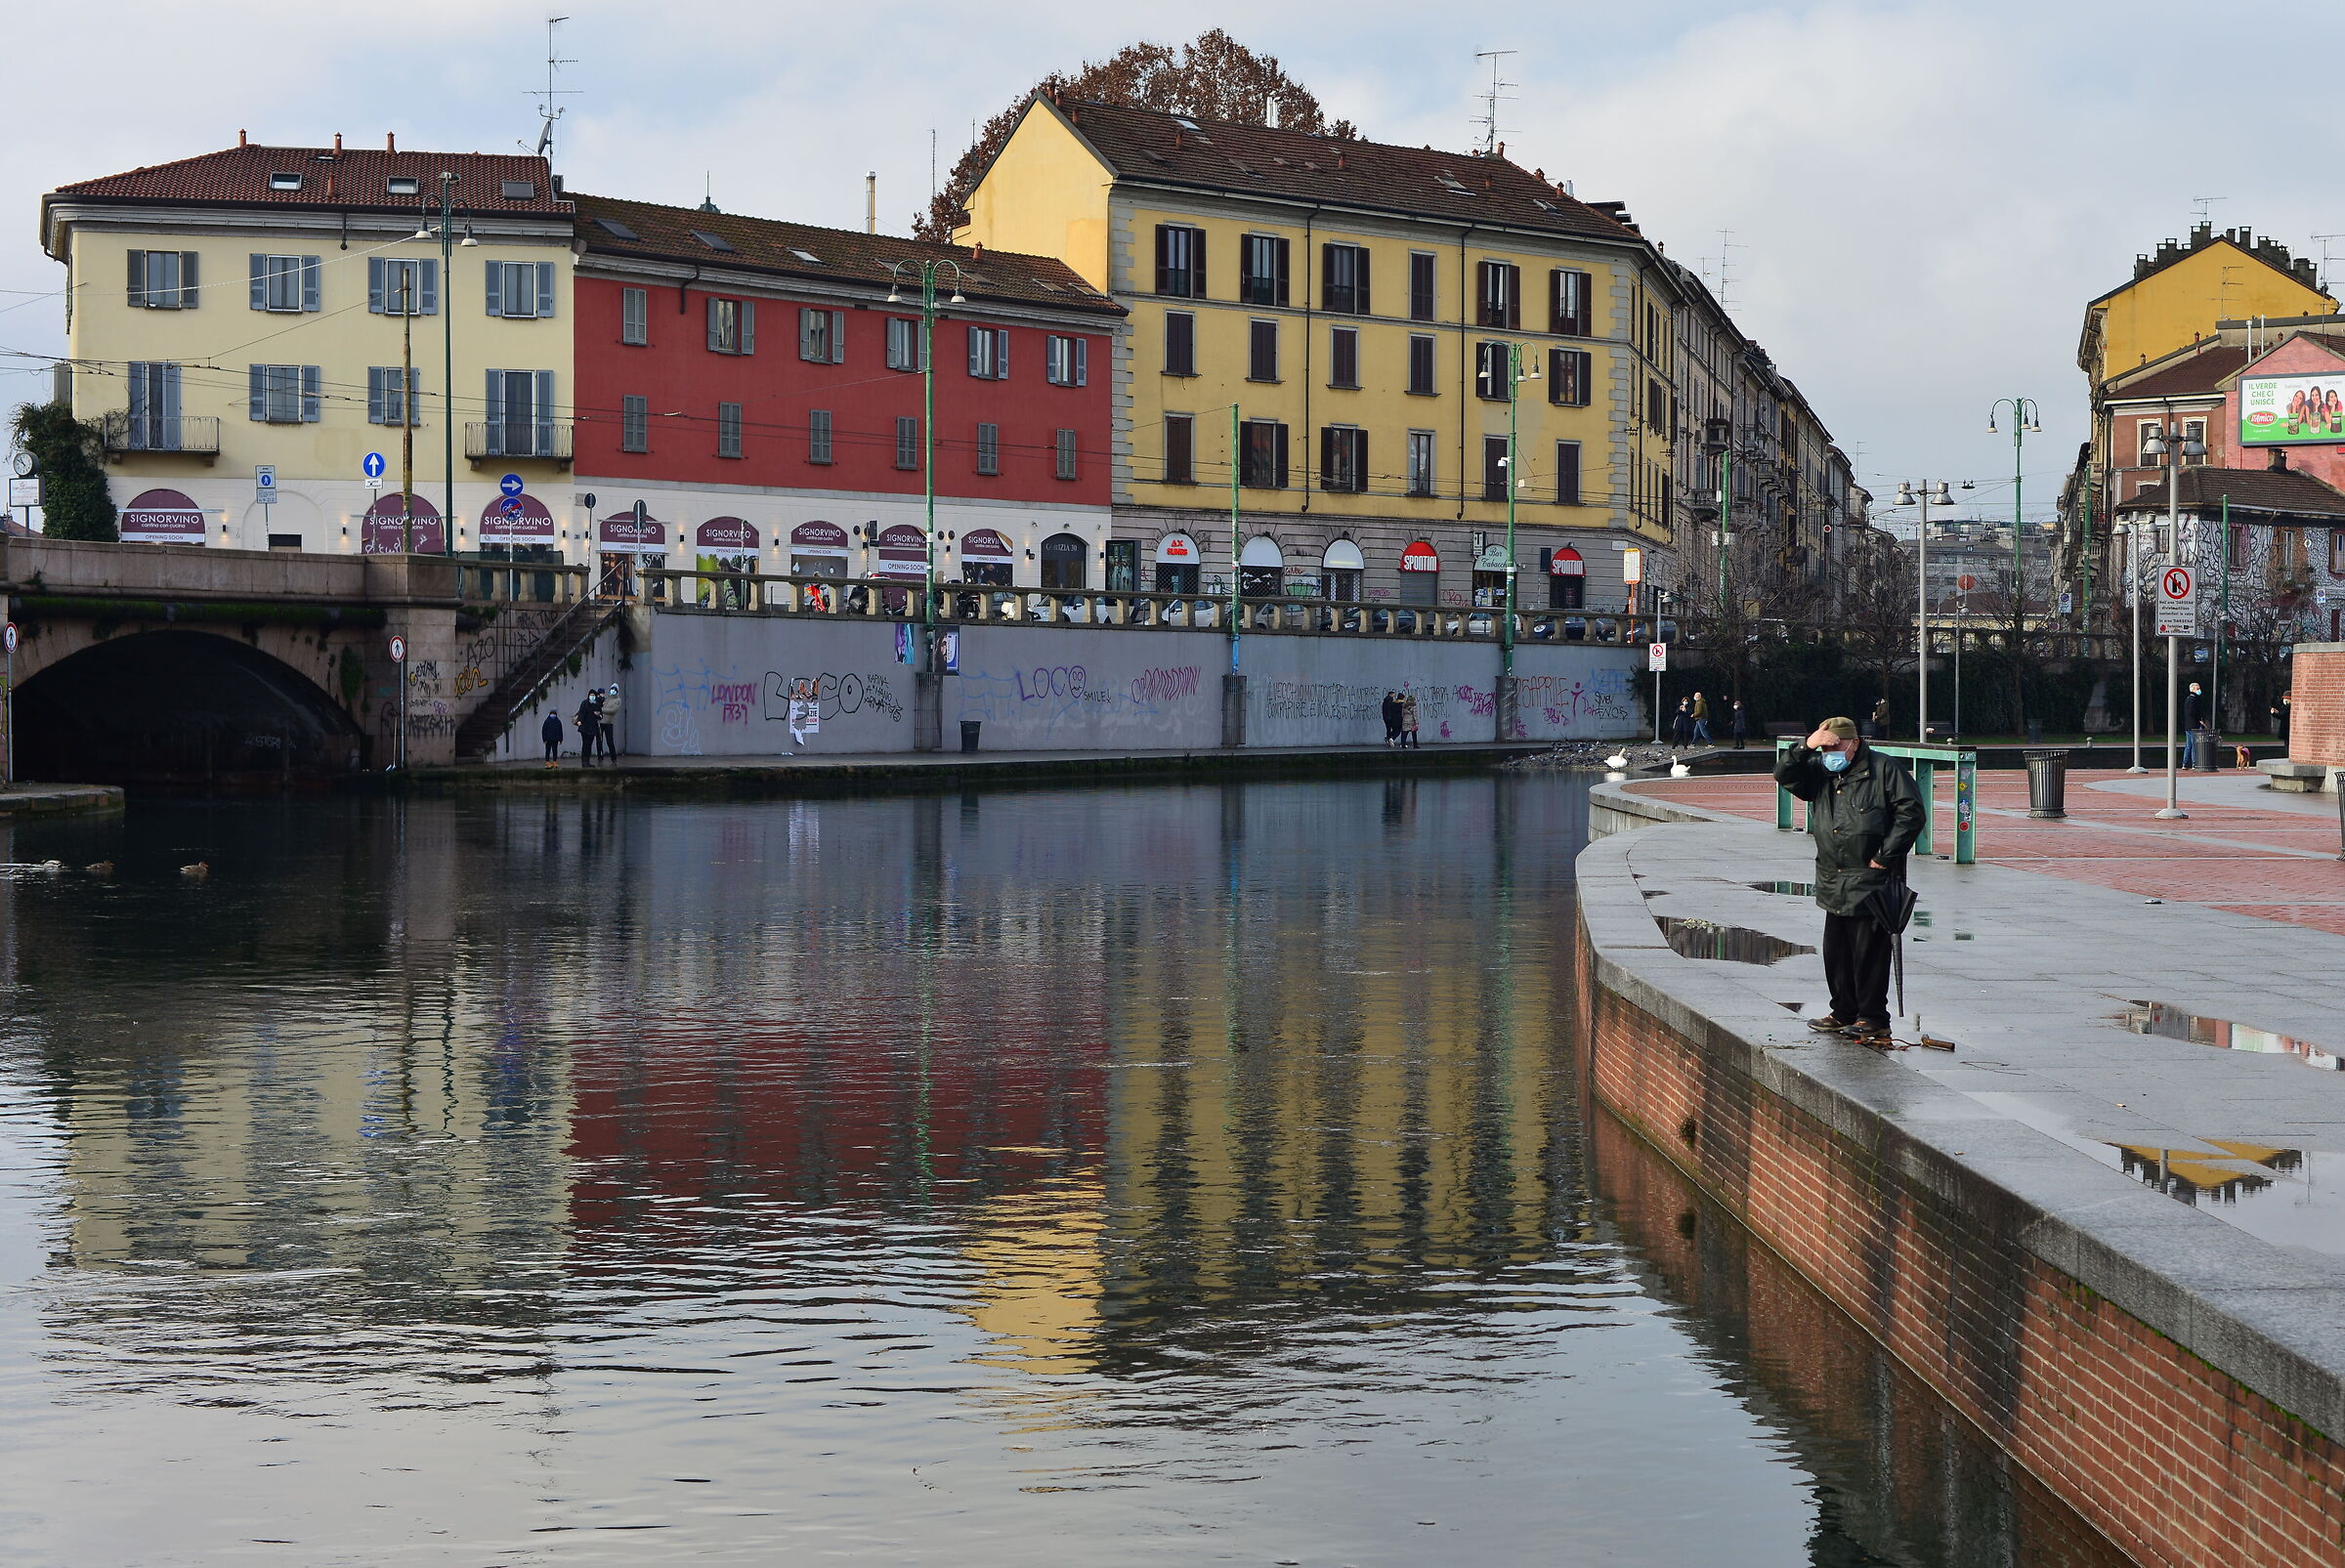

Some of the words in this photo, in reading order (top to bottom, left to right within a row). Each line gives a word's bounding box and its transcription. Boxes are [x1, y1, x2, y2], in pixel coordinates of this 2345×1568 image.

[130, 514, 199, 524] SIGNORVINO
[369, 517, 437, 526] SIGNOVINO
[705, 529, 751, 538] SIGNORVIO
[798, 528, 841, 537] SIGNORVINO
[1488, 546, 1503, 558] Bar
[1481, 557, 1508, 569] Tabacch
[710, 682, 757, 705] LONDON
